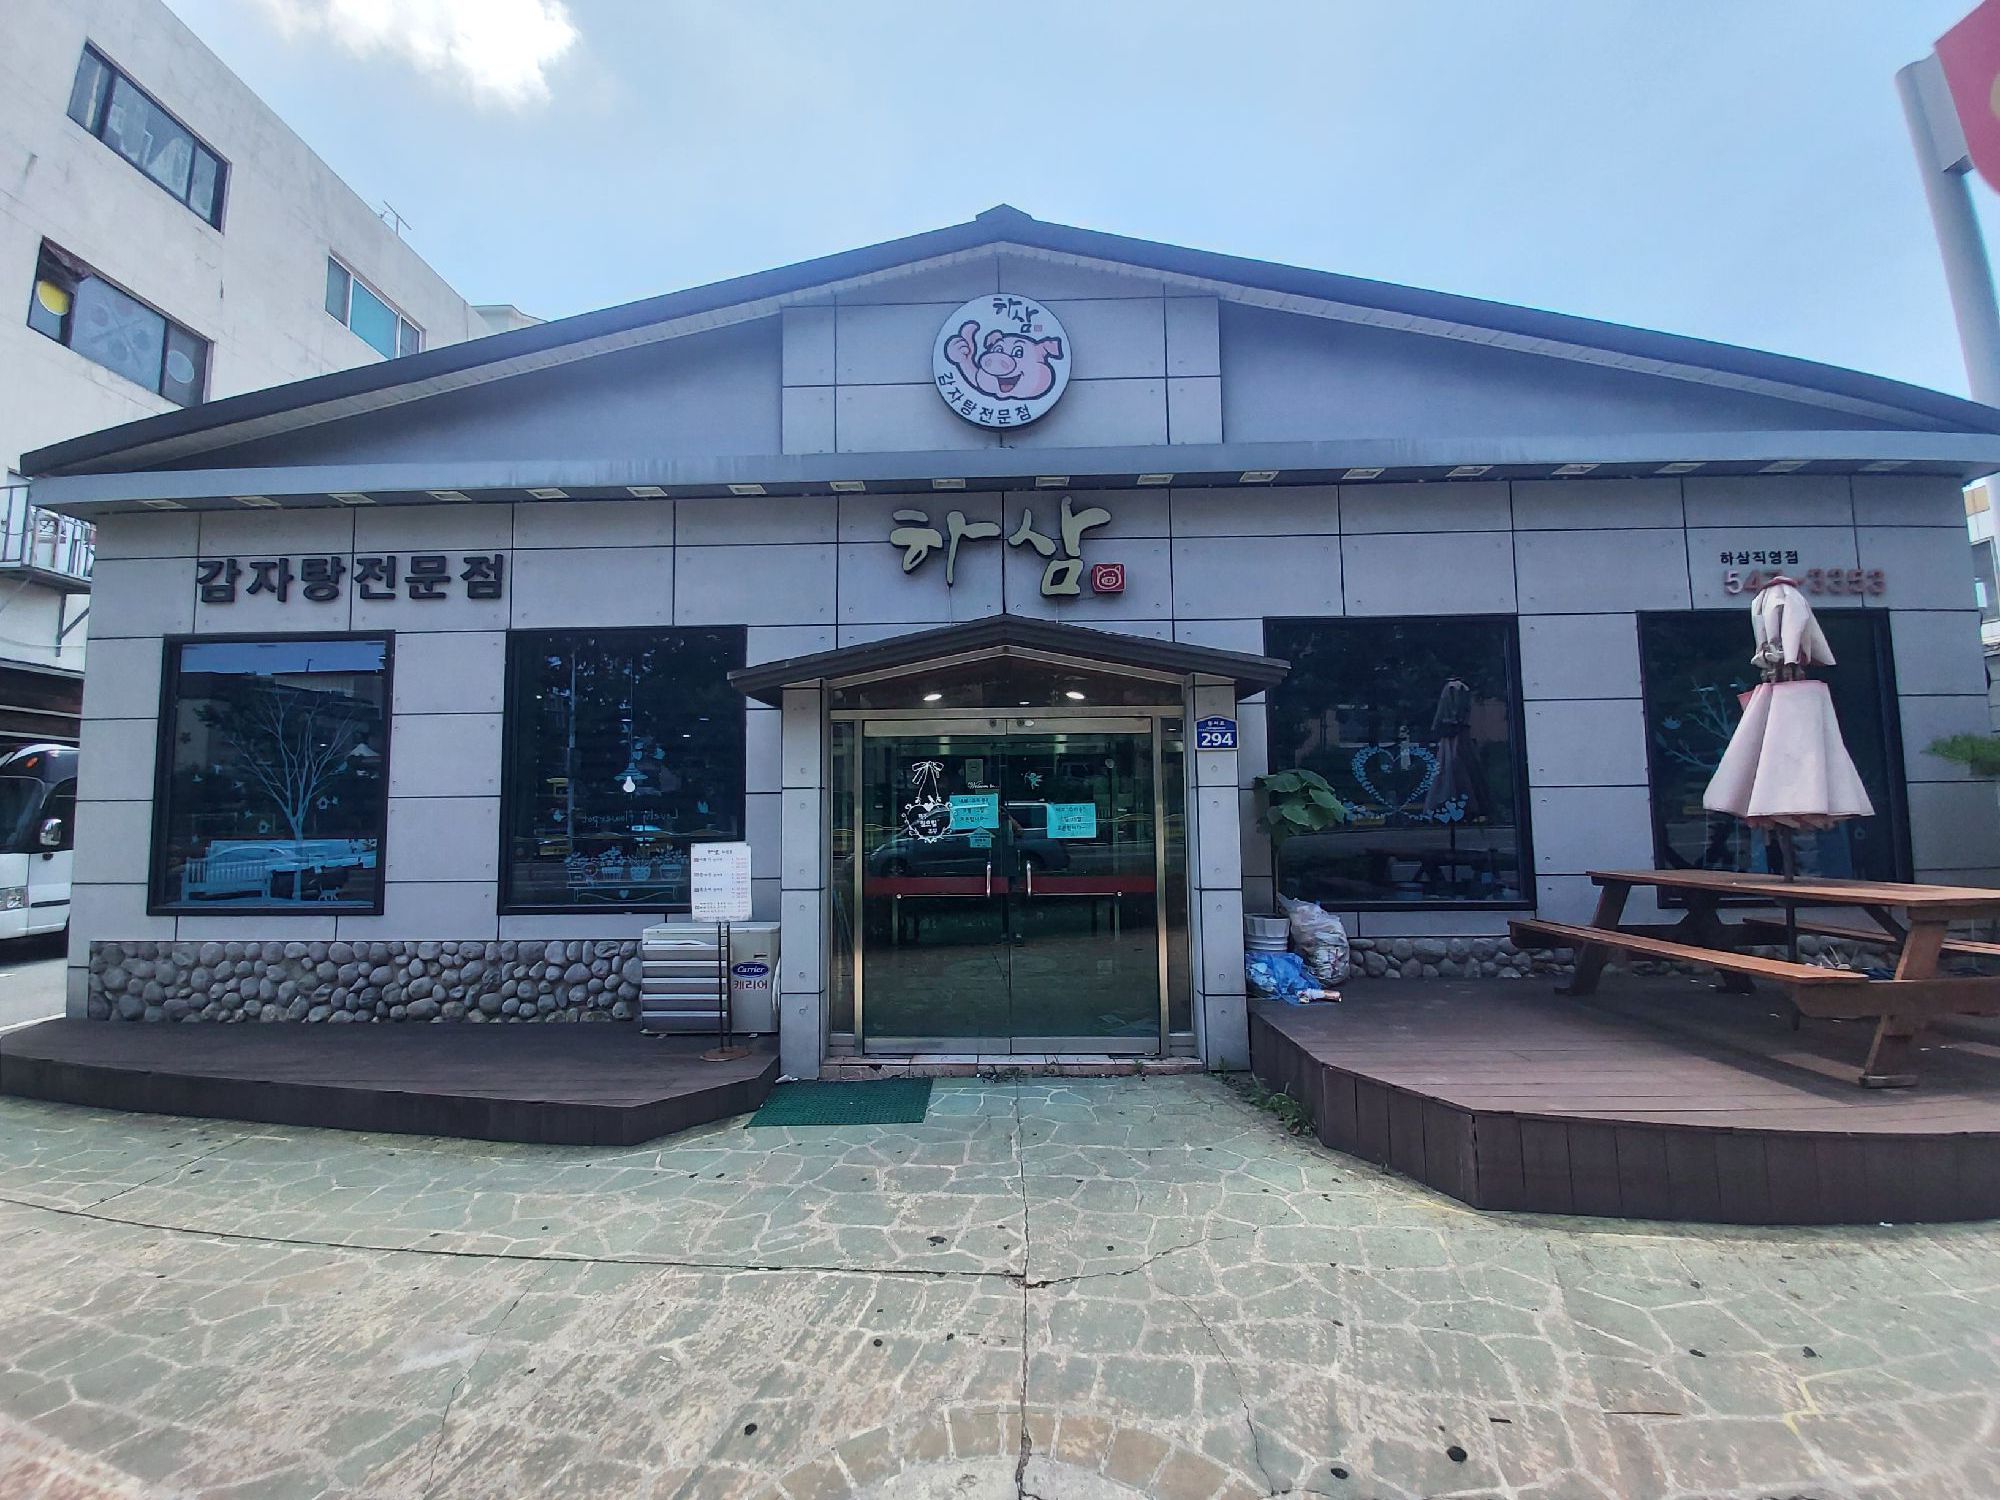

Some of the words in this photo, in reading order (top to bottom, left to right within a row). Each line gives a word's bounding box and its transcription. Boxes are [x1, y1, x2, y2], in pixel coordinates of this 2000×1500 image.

[937, 371, 1032, 424] 감자탕전문점
[889, 496, 1112, 597] 하삼
[1719, 550, 1799, 565] 하삼직영점
[196, 553, 505, 603] 감자탕전문점
[1201, 732, 1233, 746] 294
[737, 965, 765, 973] Carrier
